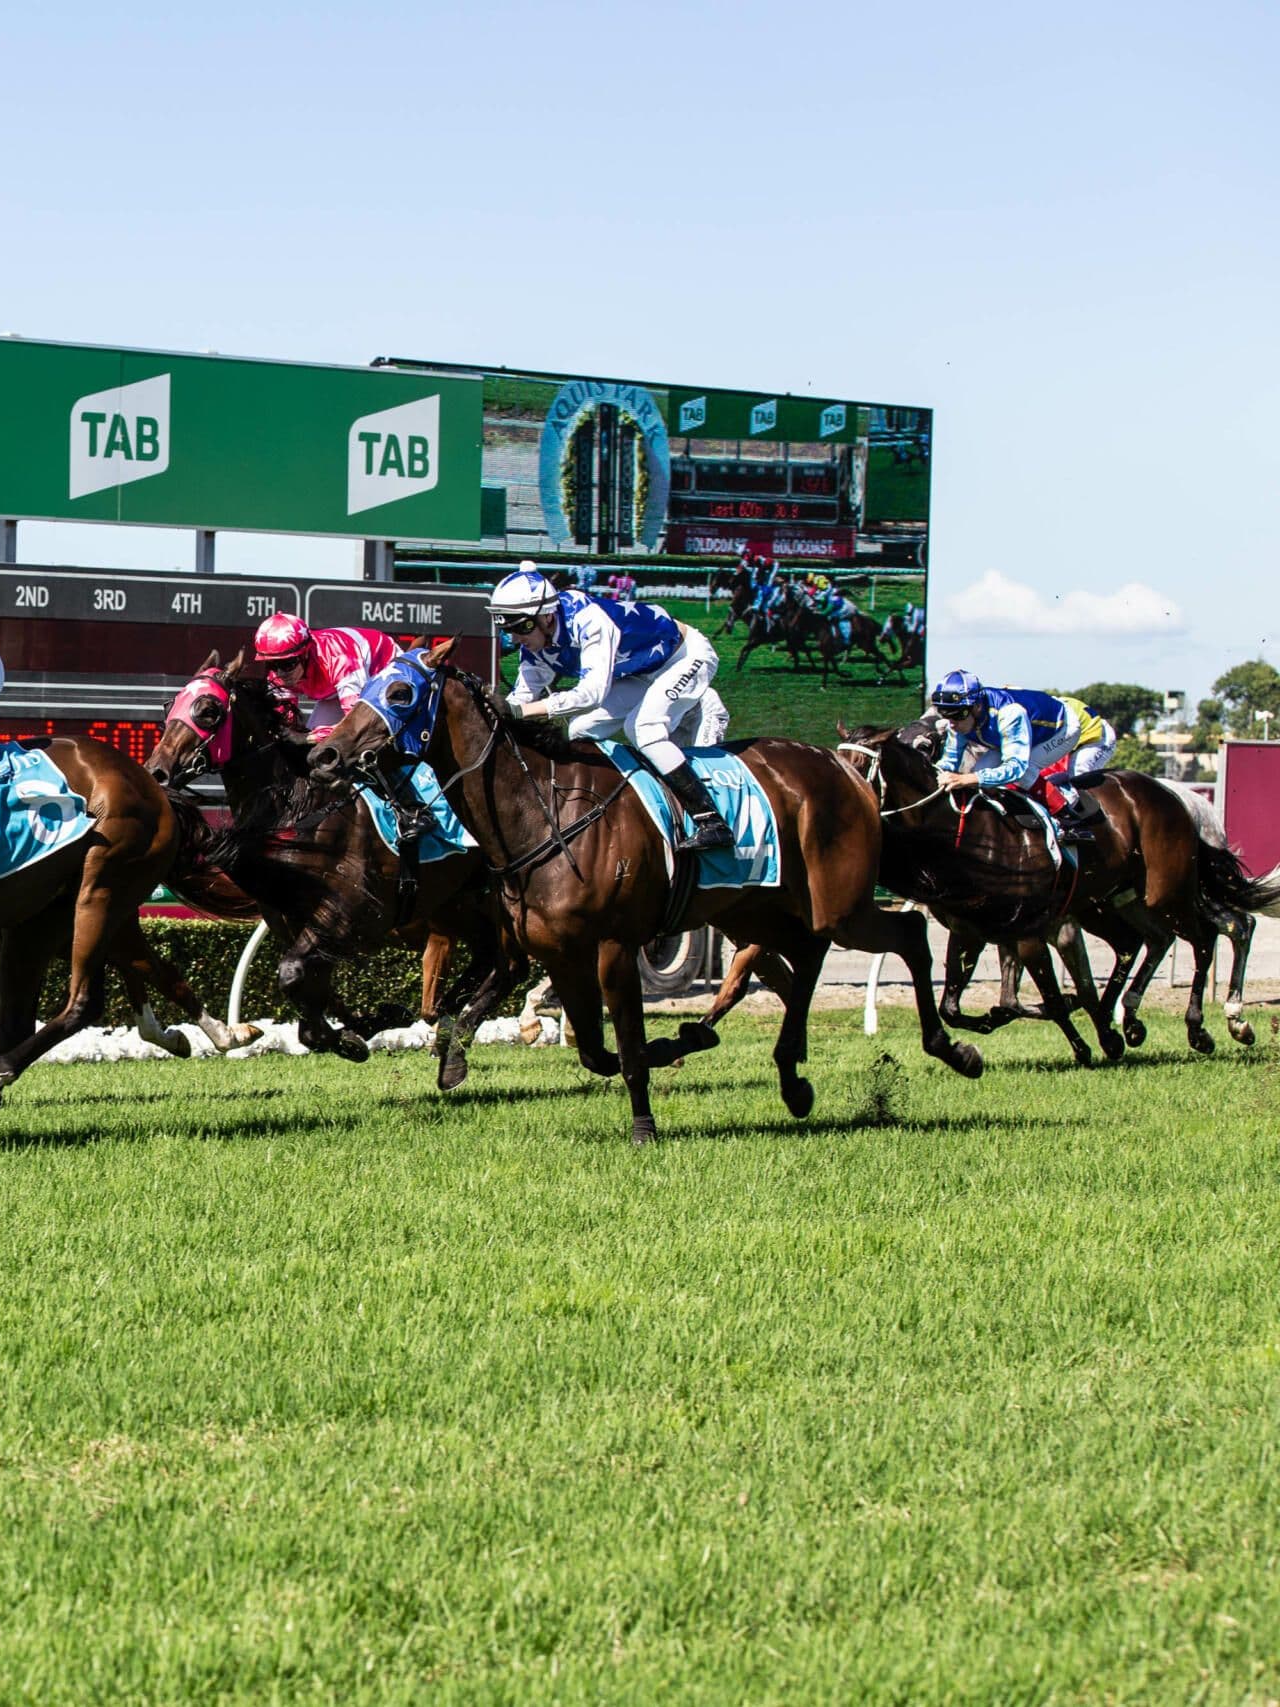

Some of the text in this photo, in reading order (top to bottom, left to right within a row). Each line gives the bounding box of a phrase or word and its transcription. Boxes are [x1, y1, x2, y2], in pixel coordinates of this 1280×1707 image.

[615, 383, 663, 446] PARK
[683, 407, 703, 421] TAB
[754, 410, 774, 424] TAB
[824, 412, 843, 427] TAB
[80, 412, 161, 463] TAB
[358, 431, 431, 479] TAB
[15, 585, 49, 607] 2ND
[93, 588, 126, 611] 3RD
[171, 592, 202, 614] 4TH
[247, 596, 276, 617] 5TH
[362, 601, 442, 625] RACE TIME
[665, 659, 704, 701] Orman
